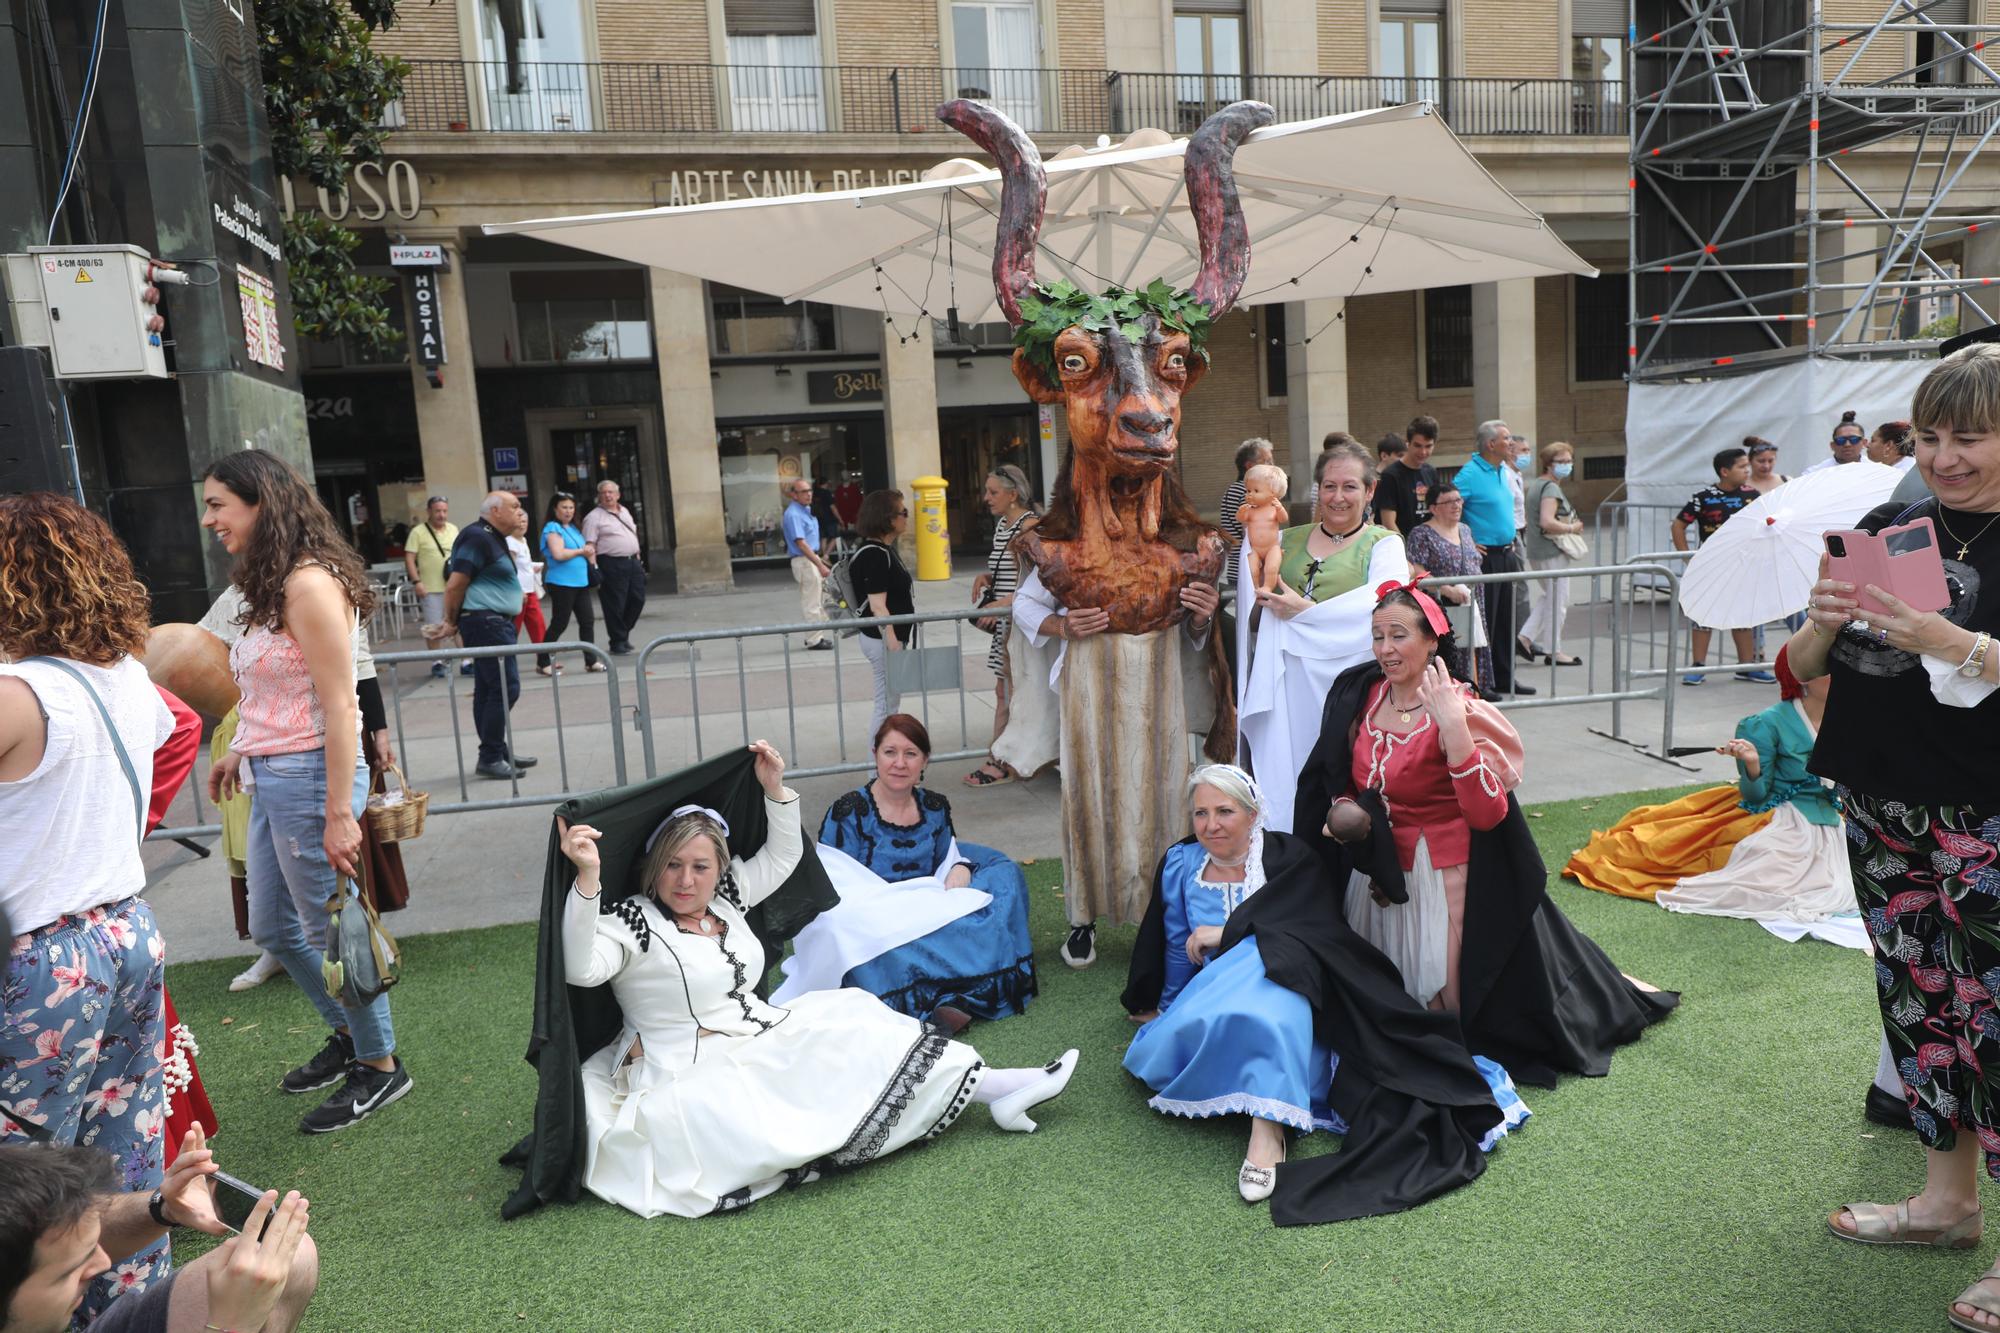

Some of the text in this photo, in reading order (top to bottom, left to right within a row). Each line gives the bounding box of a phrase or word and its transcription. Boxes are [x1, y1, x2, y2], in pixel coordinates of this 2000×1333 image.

[214, 203, 245, 238] Palacio
[233, 194, 262, 227] Junto al
[415, 275, 436, 359] HOSTAL
